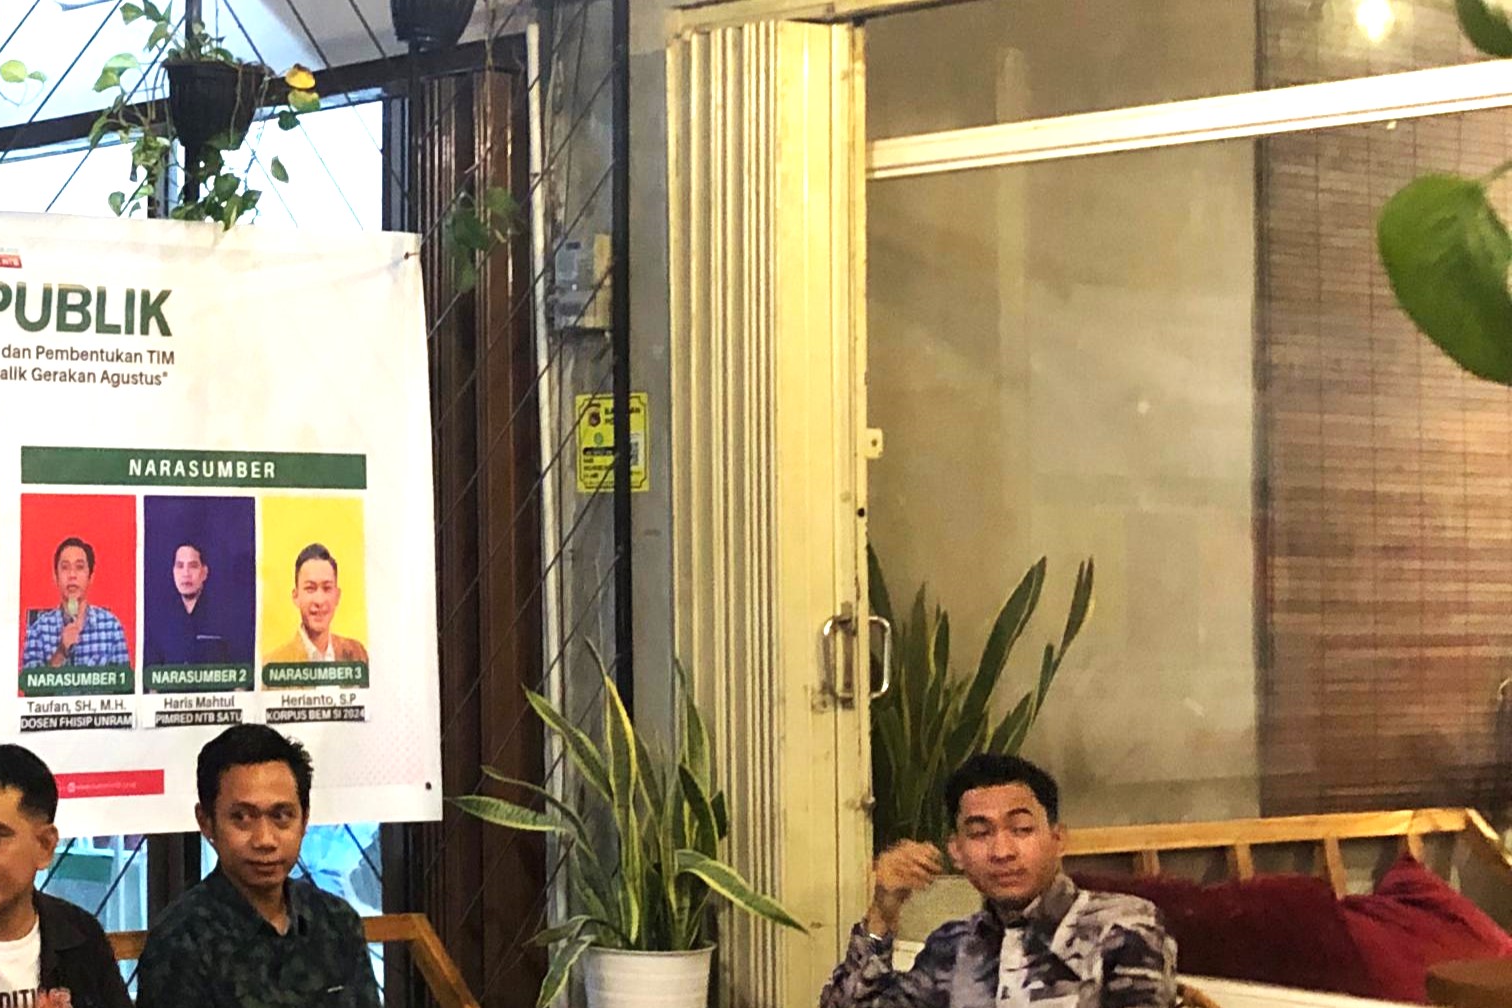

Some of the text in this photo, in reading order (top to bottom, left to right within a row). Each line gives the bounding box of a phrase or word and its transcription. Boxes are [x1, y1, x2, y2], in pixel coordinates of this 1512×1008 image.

[1, 344, 31, 359] dan
[35, 345, 143, 364] Pembentukan
[146, 349, 175, 365] TIM
[31, 368, 96, 384] Gerakan
[100, 370, 169, 388] Agustus"
[128, 458, 276, 479] NARASUMBER
[27, 672, 126, 687] NARASUMBER 1
[151, 668, 247, 684] NARASUMBER 2
[269, 666, 362, 681] NARASUMBER 3
[27, 700, 72, 714] Taufan,
[100, 699, 127, 711] M.H.
[164, 696, 193, 709] Haris
[20, 716, 57, 730] DOSEN
[93, 715, 132, 727] UNRAM
[155, 711, 242, 725] PIMRED NTB SATU
[266, 710, 307, 721] KORPUS
[308, 709, 331, 720] BEM
